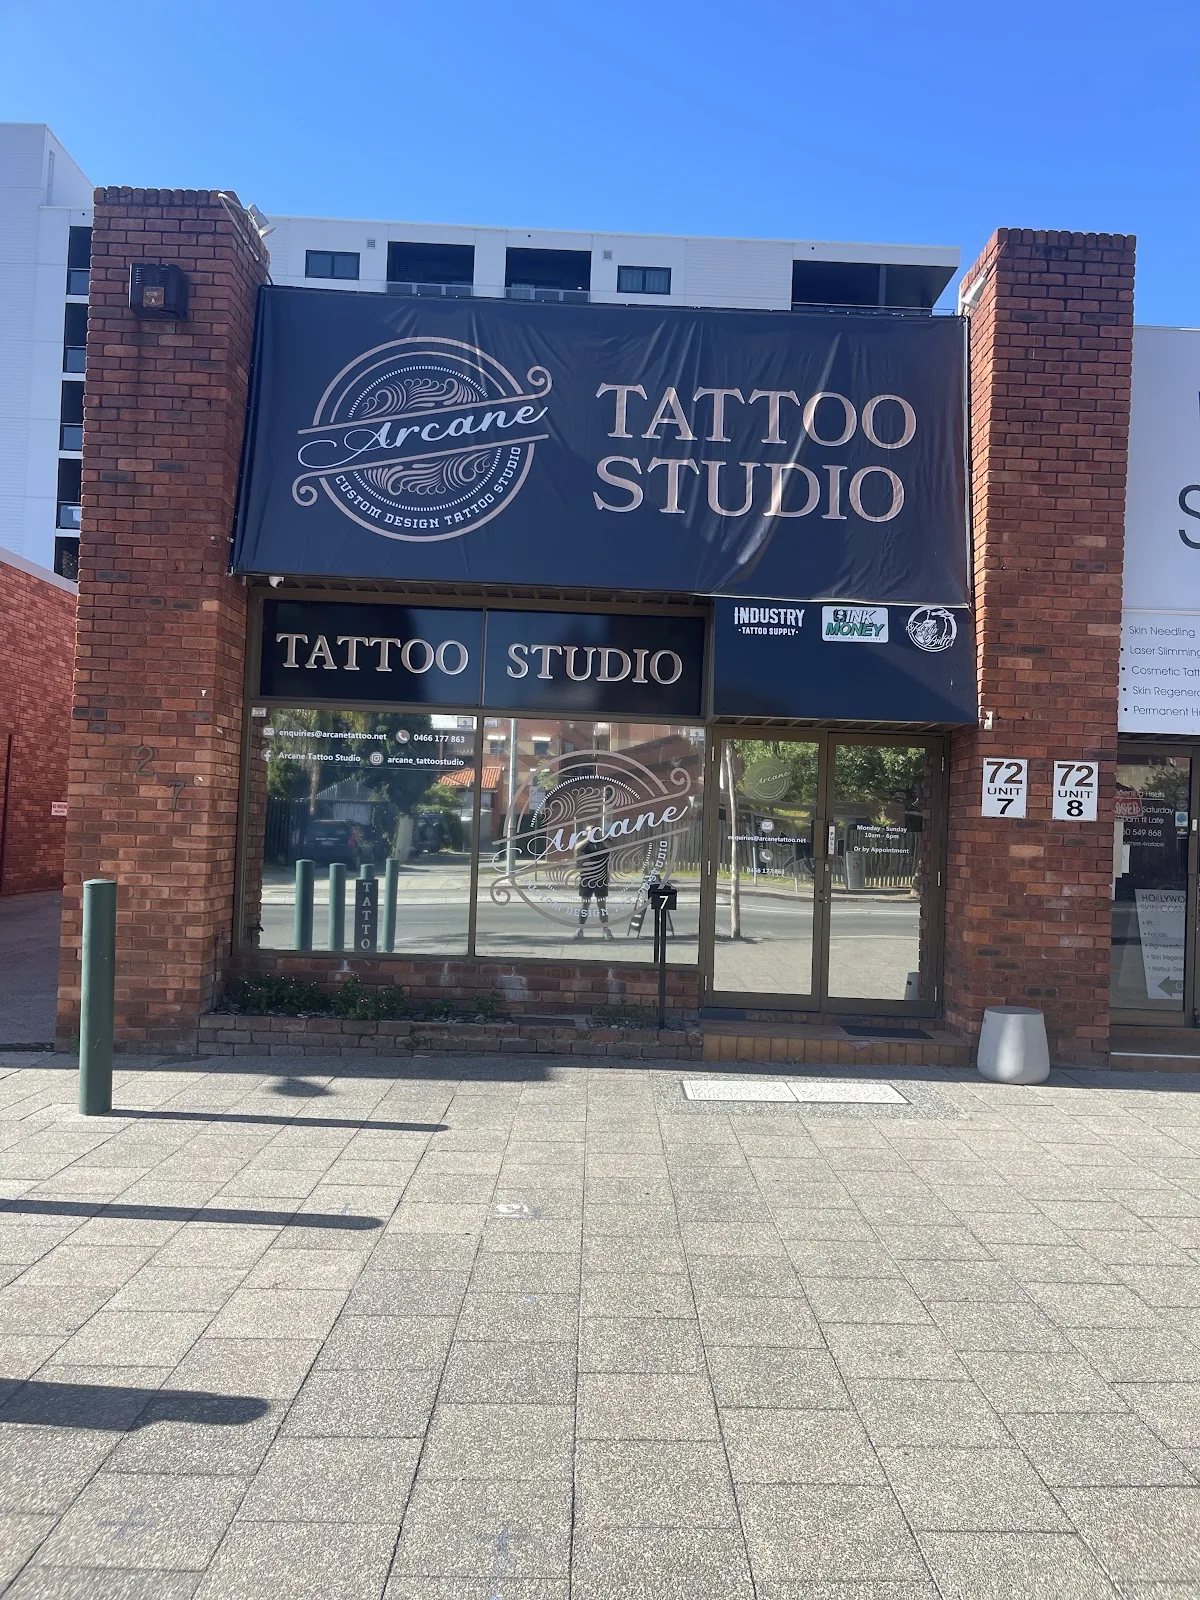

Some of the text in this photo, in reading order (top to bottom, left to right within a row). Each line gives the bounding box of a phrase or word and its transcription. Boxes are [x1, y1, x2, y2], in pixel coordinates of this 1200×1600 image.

[595, 382, 917, 449] TATTOO
[297, 404, 549, 469] Arcane
[335, 446, 521, 529] CUSTOM DESIGN TATTOO STUDIO
[592, 455, 905, 523] STUDIO
[734, 606, 805, 627] INDUSTRY
[741, 626, 796, 636] TATTOO SUPPLY
[825, 622, 886, 637] MONEY
[1128, 625, 1196, 639] Skin Needling
[276, 632, 683, 686] TATTOO STUDIO
[1129, 645, 1200, 659] Laser Slimming
[1131, 665, 1180, 677] Cosmetic
[1132, 685, 1151, 695] Skin
[1133, 705, 1189, 716] Permanent
[278, 729, 466, 744] enquiries@arcanetattoo.net 0466 177 863
[135, 745, 154, 776] 2
[278, 751, 361, 763] Arcane Tattoo Studio
[387, 756, 465, 767] arcane_tattoostudio
[986, 761, 1023, 785] 72
[1057, 763, 1094, 788] 72
[987, 787, 1023, 796] UNIT
[1057, 790, 1093, 799] UNIT
[996, 798, 1015, 815] 7
[1066, 800, 1084, 817] 8
[1142, 805, 1174, 815] Saturday
[1148, 816, 1165, 824] Late
[856, 825, 881, 833] Monday
[885, 826, 908, 834] Sunday
[1132, 828, 1147, 836] 549
[1147, 829, 1162, 837] 868
[491, 805, 688, 873] Arcane
[862, 846, 870, 854] by
[870, 847, 910, 855] Appointment
[522, 877, 561, 912] USTOM
[565, 907, 609, 918] DESIGN
[647, 840, 668, 883] STUDIO
[659, 896, 669, 910] 7
